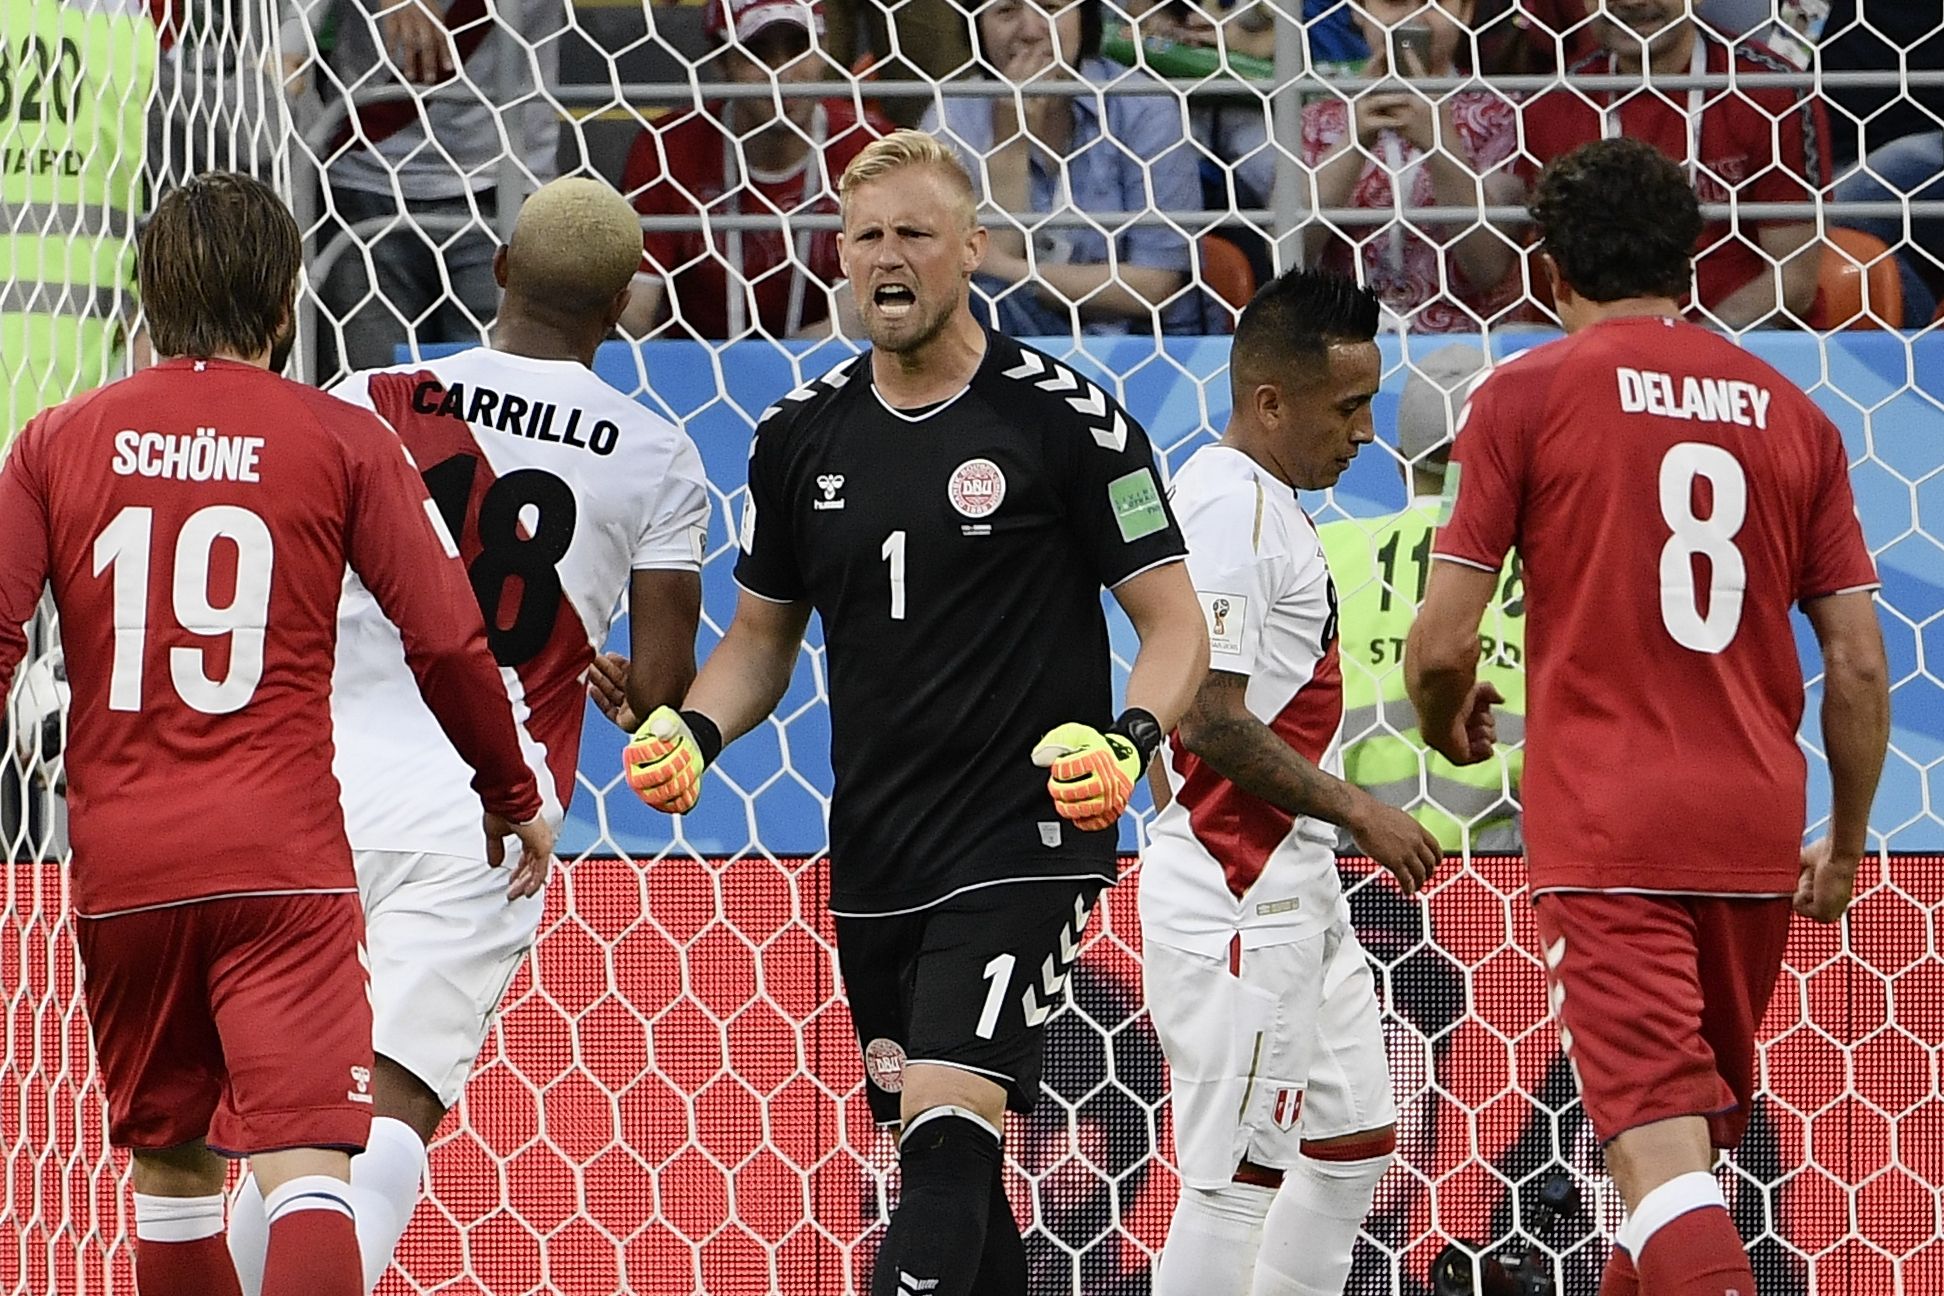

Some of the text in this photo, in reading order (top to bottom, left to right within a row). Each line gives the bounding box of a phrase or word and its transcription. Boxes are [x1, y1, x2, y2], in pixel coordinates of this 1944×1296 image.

[412, 380, 619, 456] CARRILLO
[1616, 367, 1770, 430] DELANEY
[112, 427, 265, 482] SCHÖNE
[881, 530, 906, 620] 1
[1659, 441, 1747, 654] 8
[93, 505, 274, 715] 19
[1369, 633, 1522, 669] STRD
[975, 952, 1017, 1040] 1
